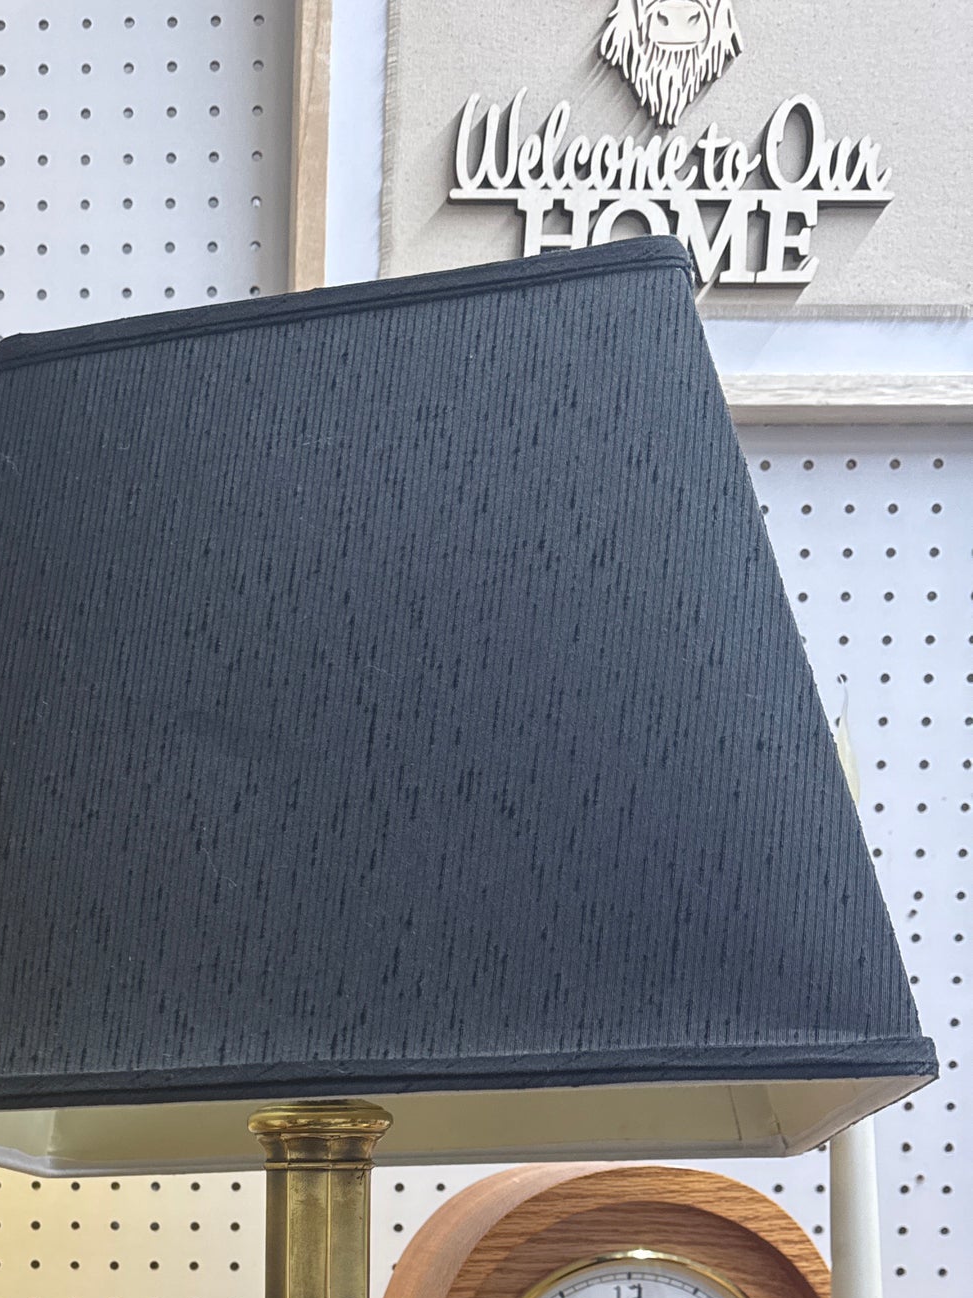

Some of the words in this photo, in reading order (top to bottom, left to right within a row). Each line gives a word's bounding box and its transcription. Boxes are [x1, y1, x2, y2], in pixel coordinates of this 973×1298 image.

[454, 87, 698, 192] Welcome
[691, 121, 763, 190] to
[760, 93, 894, 192] Our
